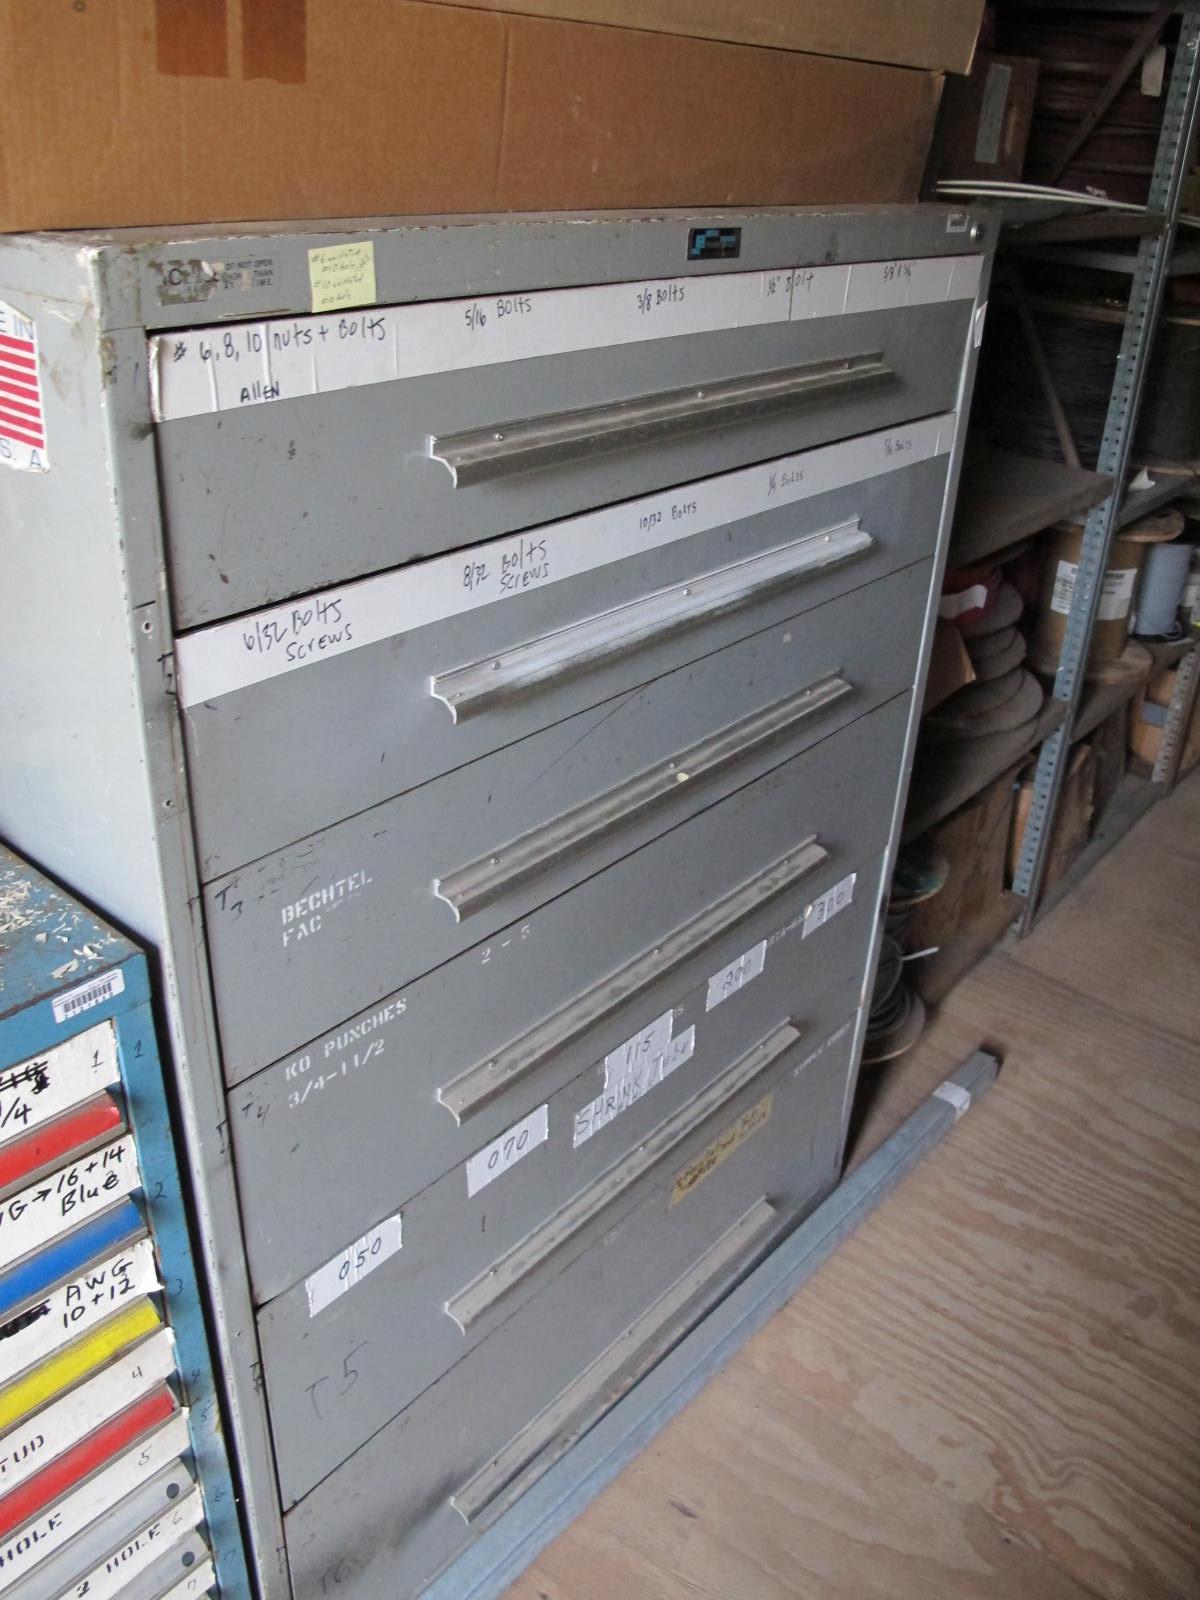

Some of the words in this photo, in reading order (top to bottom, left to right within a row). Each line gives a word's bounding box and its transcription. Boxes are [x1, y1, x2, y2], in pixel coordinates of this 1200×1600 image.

[464, 302, 488, 330] 5/16
[637, 288, 652, 315] 3/8
[12, 314, 34, 340] IN
[273, 322, 313, 351] nuts
[639, 511, 662, 532] 10/32
[463, 561, 491, 591] 8/32
[242, 621, 288, 654] 6/32
[281, 869, 374, 926] BECHTEL
[282, 914, 322, 948] FAC
[285, 1055, 311, 1083] KO
[324, 997, 407, 1059] PUNCHES
[487, 1129, 529, 1169] 070
[155, 1181, 168, 1200] 2
[338, 1236, 382, 1281] 050
[106, 1522, 161, 1574] HOLE
